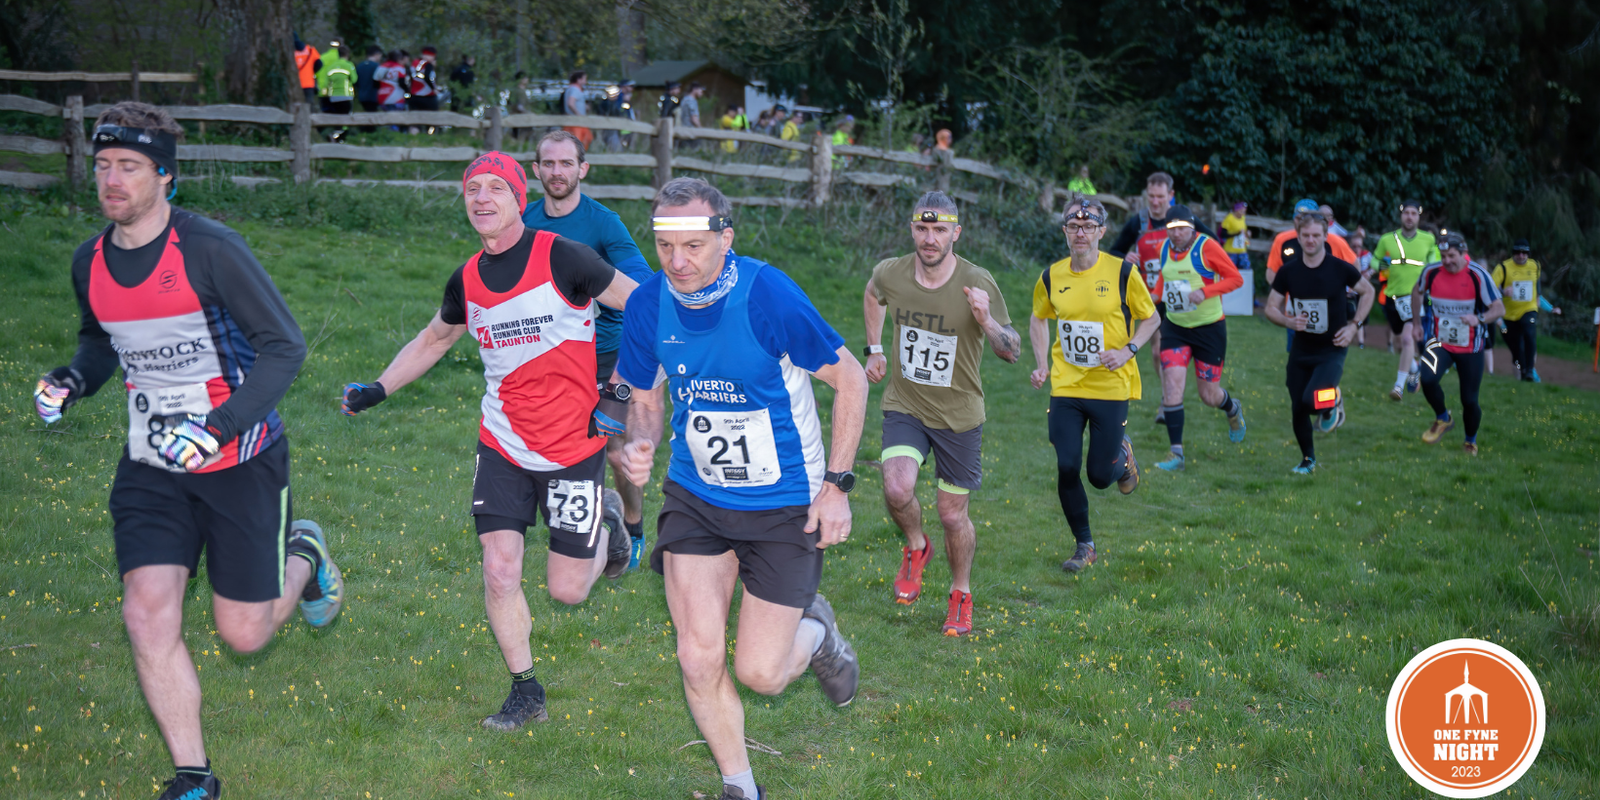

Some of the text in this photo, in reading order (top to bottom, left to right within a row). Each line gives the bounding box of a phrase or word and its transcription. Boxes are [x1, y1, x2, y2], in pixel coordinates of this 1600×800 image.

[1167, 291, 1183, 304] 81
[491, 314, 554, 332] RUNNING FOREVER
[895, 307, 956, 333] HSTL.
[492, 325, 541, 340] RUNNING CLUB
[495, 334, 541, 349] TAUNTON
[1449, 327, 1458, 339] 3
[1063, 334, 1100, 354] 108
[145, 355, 200, 373] Harriers
[904, 343, 950, 372] 115
[707, 434, 750, 465] 21
[553, 492, 589, 523] 73
